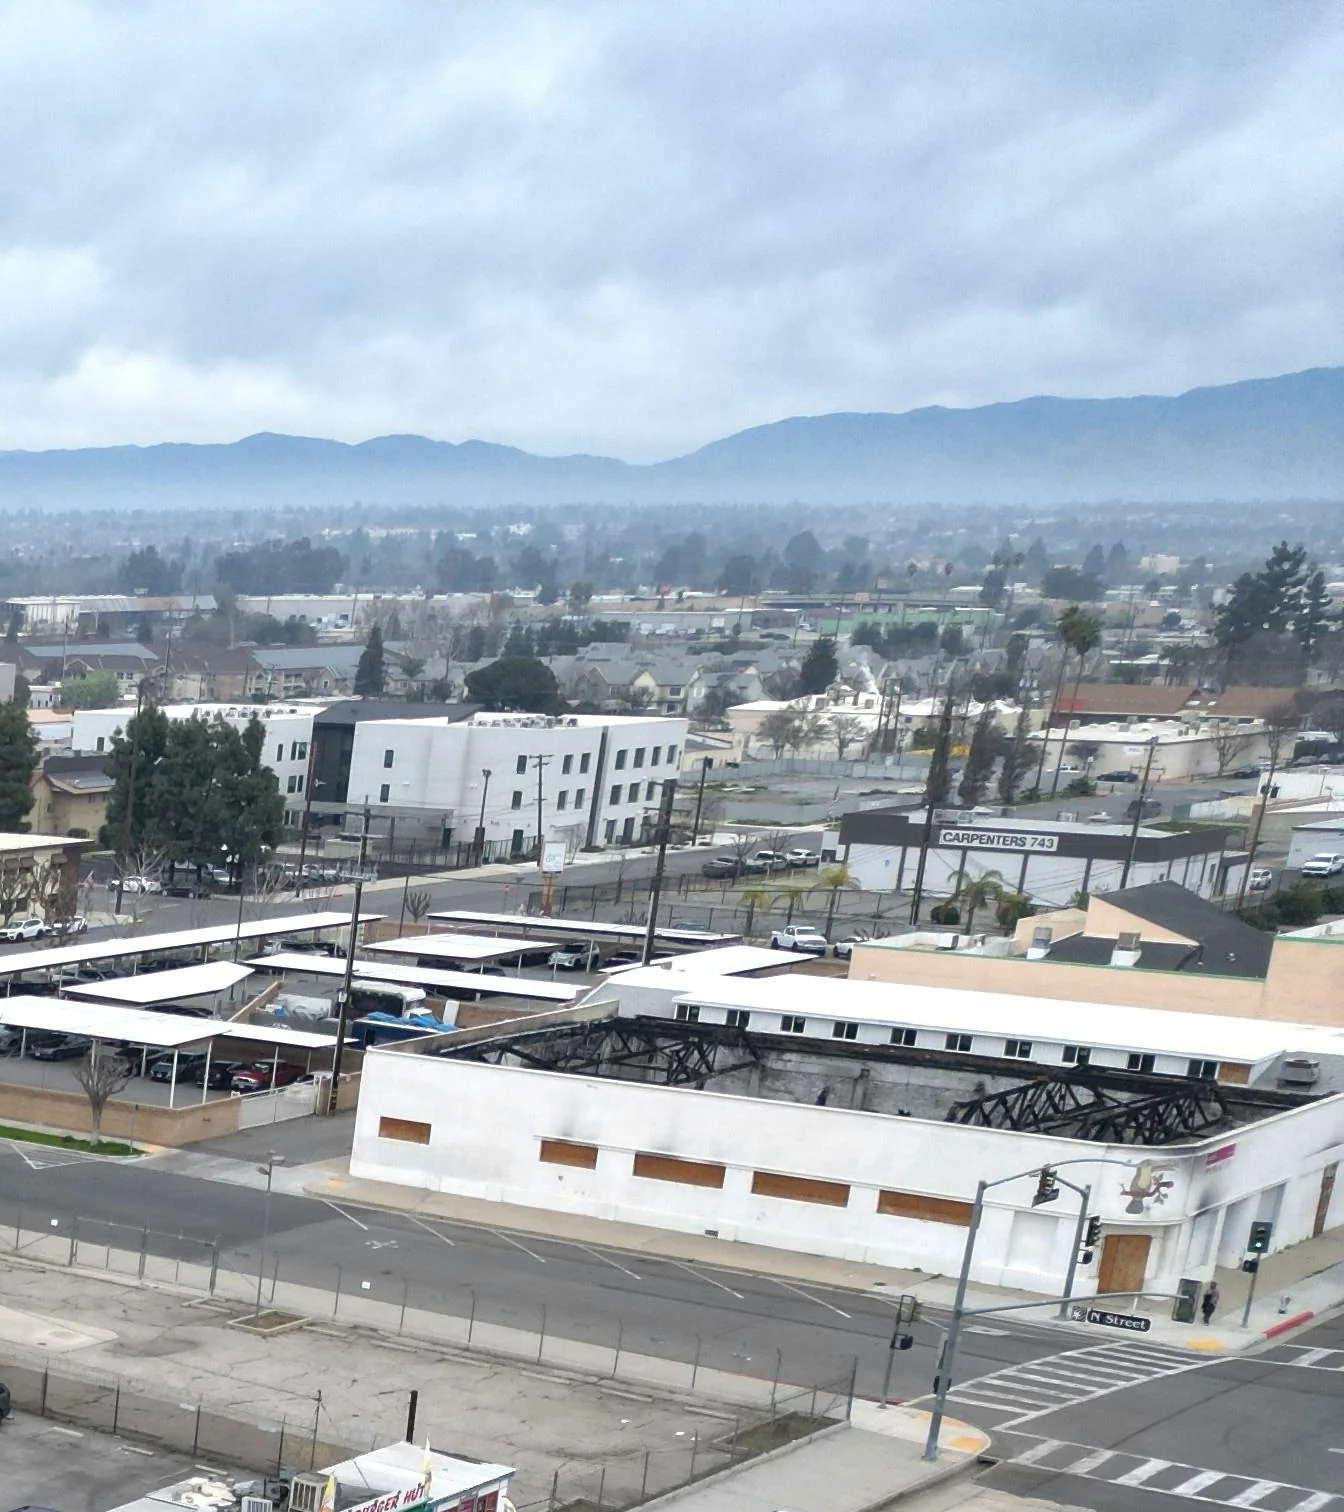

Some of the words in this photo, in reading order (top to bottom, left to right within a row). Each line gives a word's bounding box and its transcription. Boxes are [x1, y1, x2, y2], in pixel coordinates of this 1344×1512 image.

[943, 832, 1026, 847] CARPENTERS
[1030, 837, 1054, 849] 743
[1090, 1312, 1101, 1322] N
[1105, 1315, 1146, 1330] Street
[403, 1482, 426, 1505] HUT
